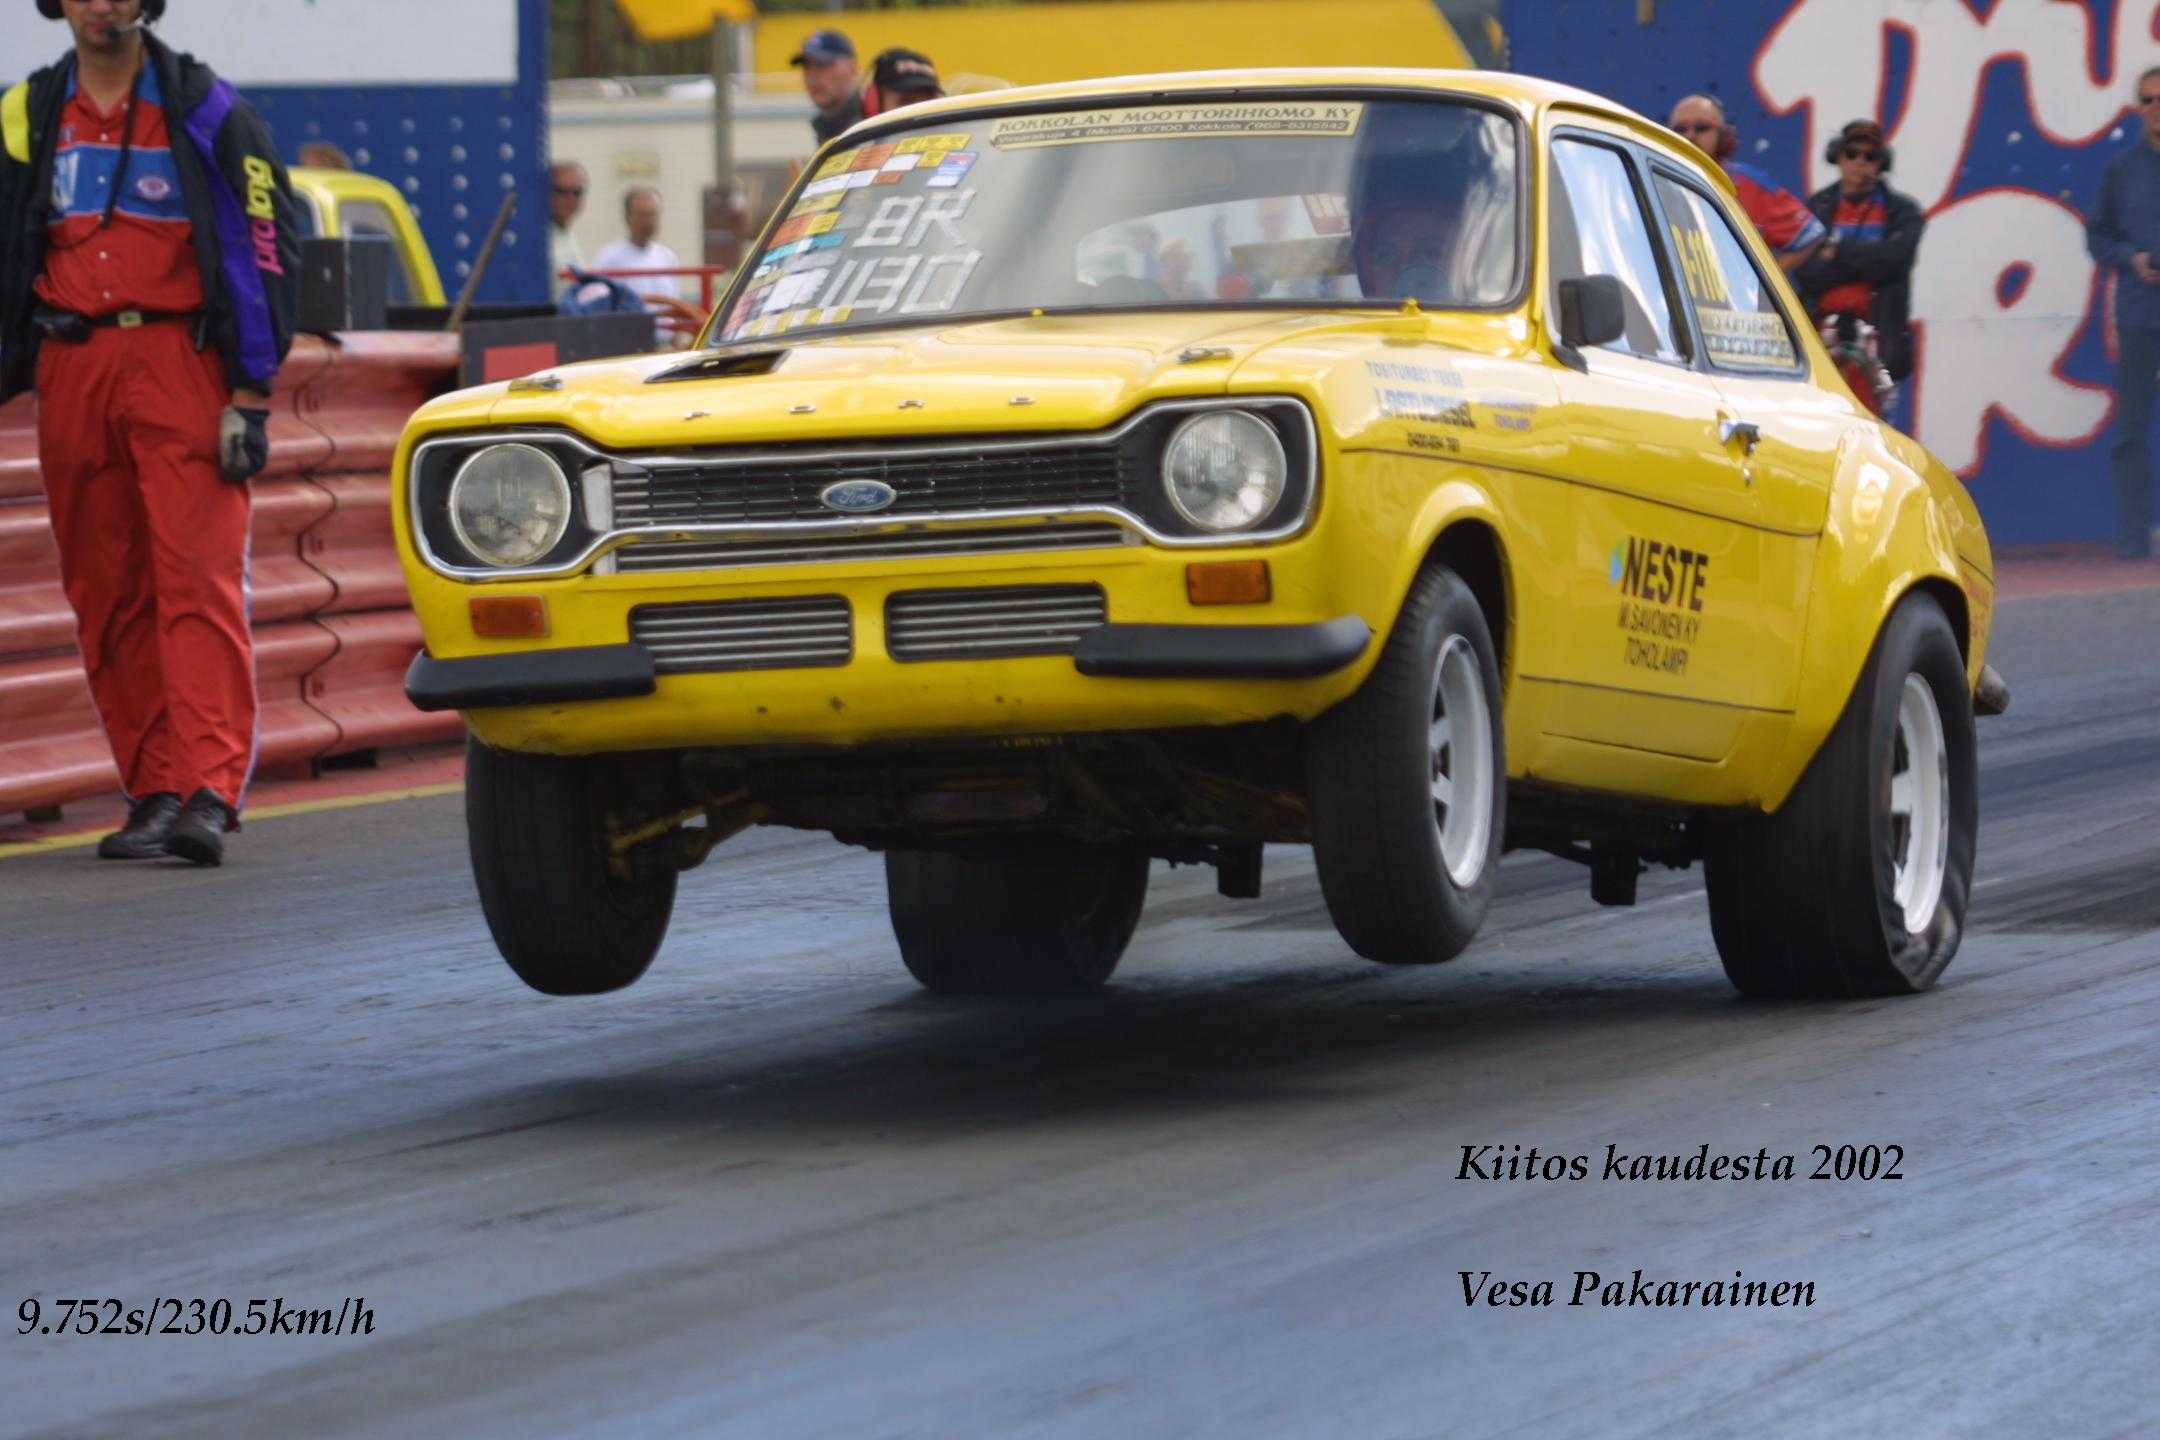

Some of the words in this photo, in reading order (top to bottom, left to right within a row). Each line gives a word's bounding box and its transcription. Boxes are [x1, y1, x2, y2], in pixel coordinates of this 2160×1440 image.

[999, 113, 1113, 133] KOKKOLAN
[1121, 107, 1315, 123] MOOTTORIHIOMO
[1325, 107, 1355, 119] KY
[1621, 535, 1709, 612] NESTE
